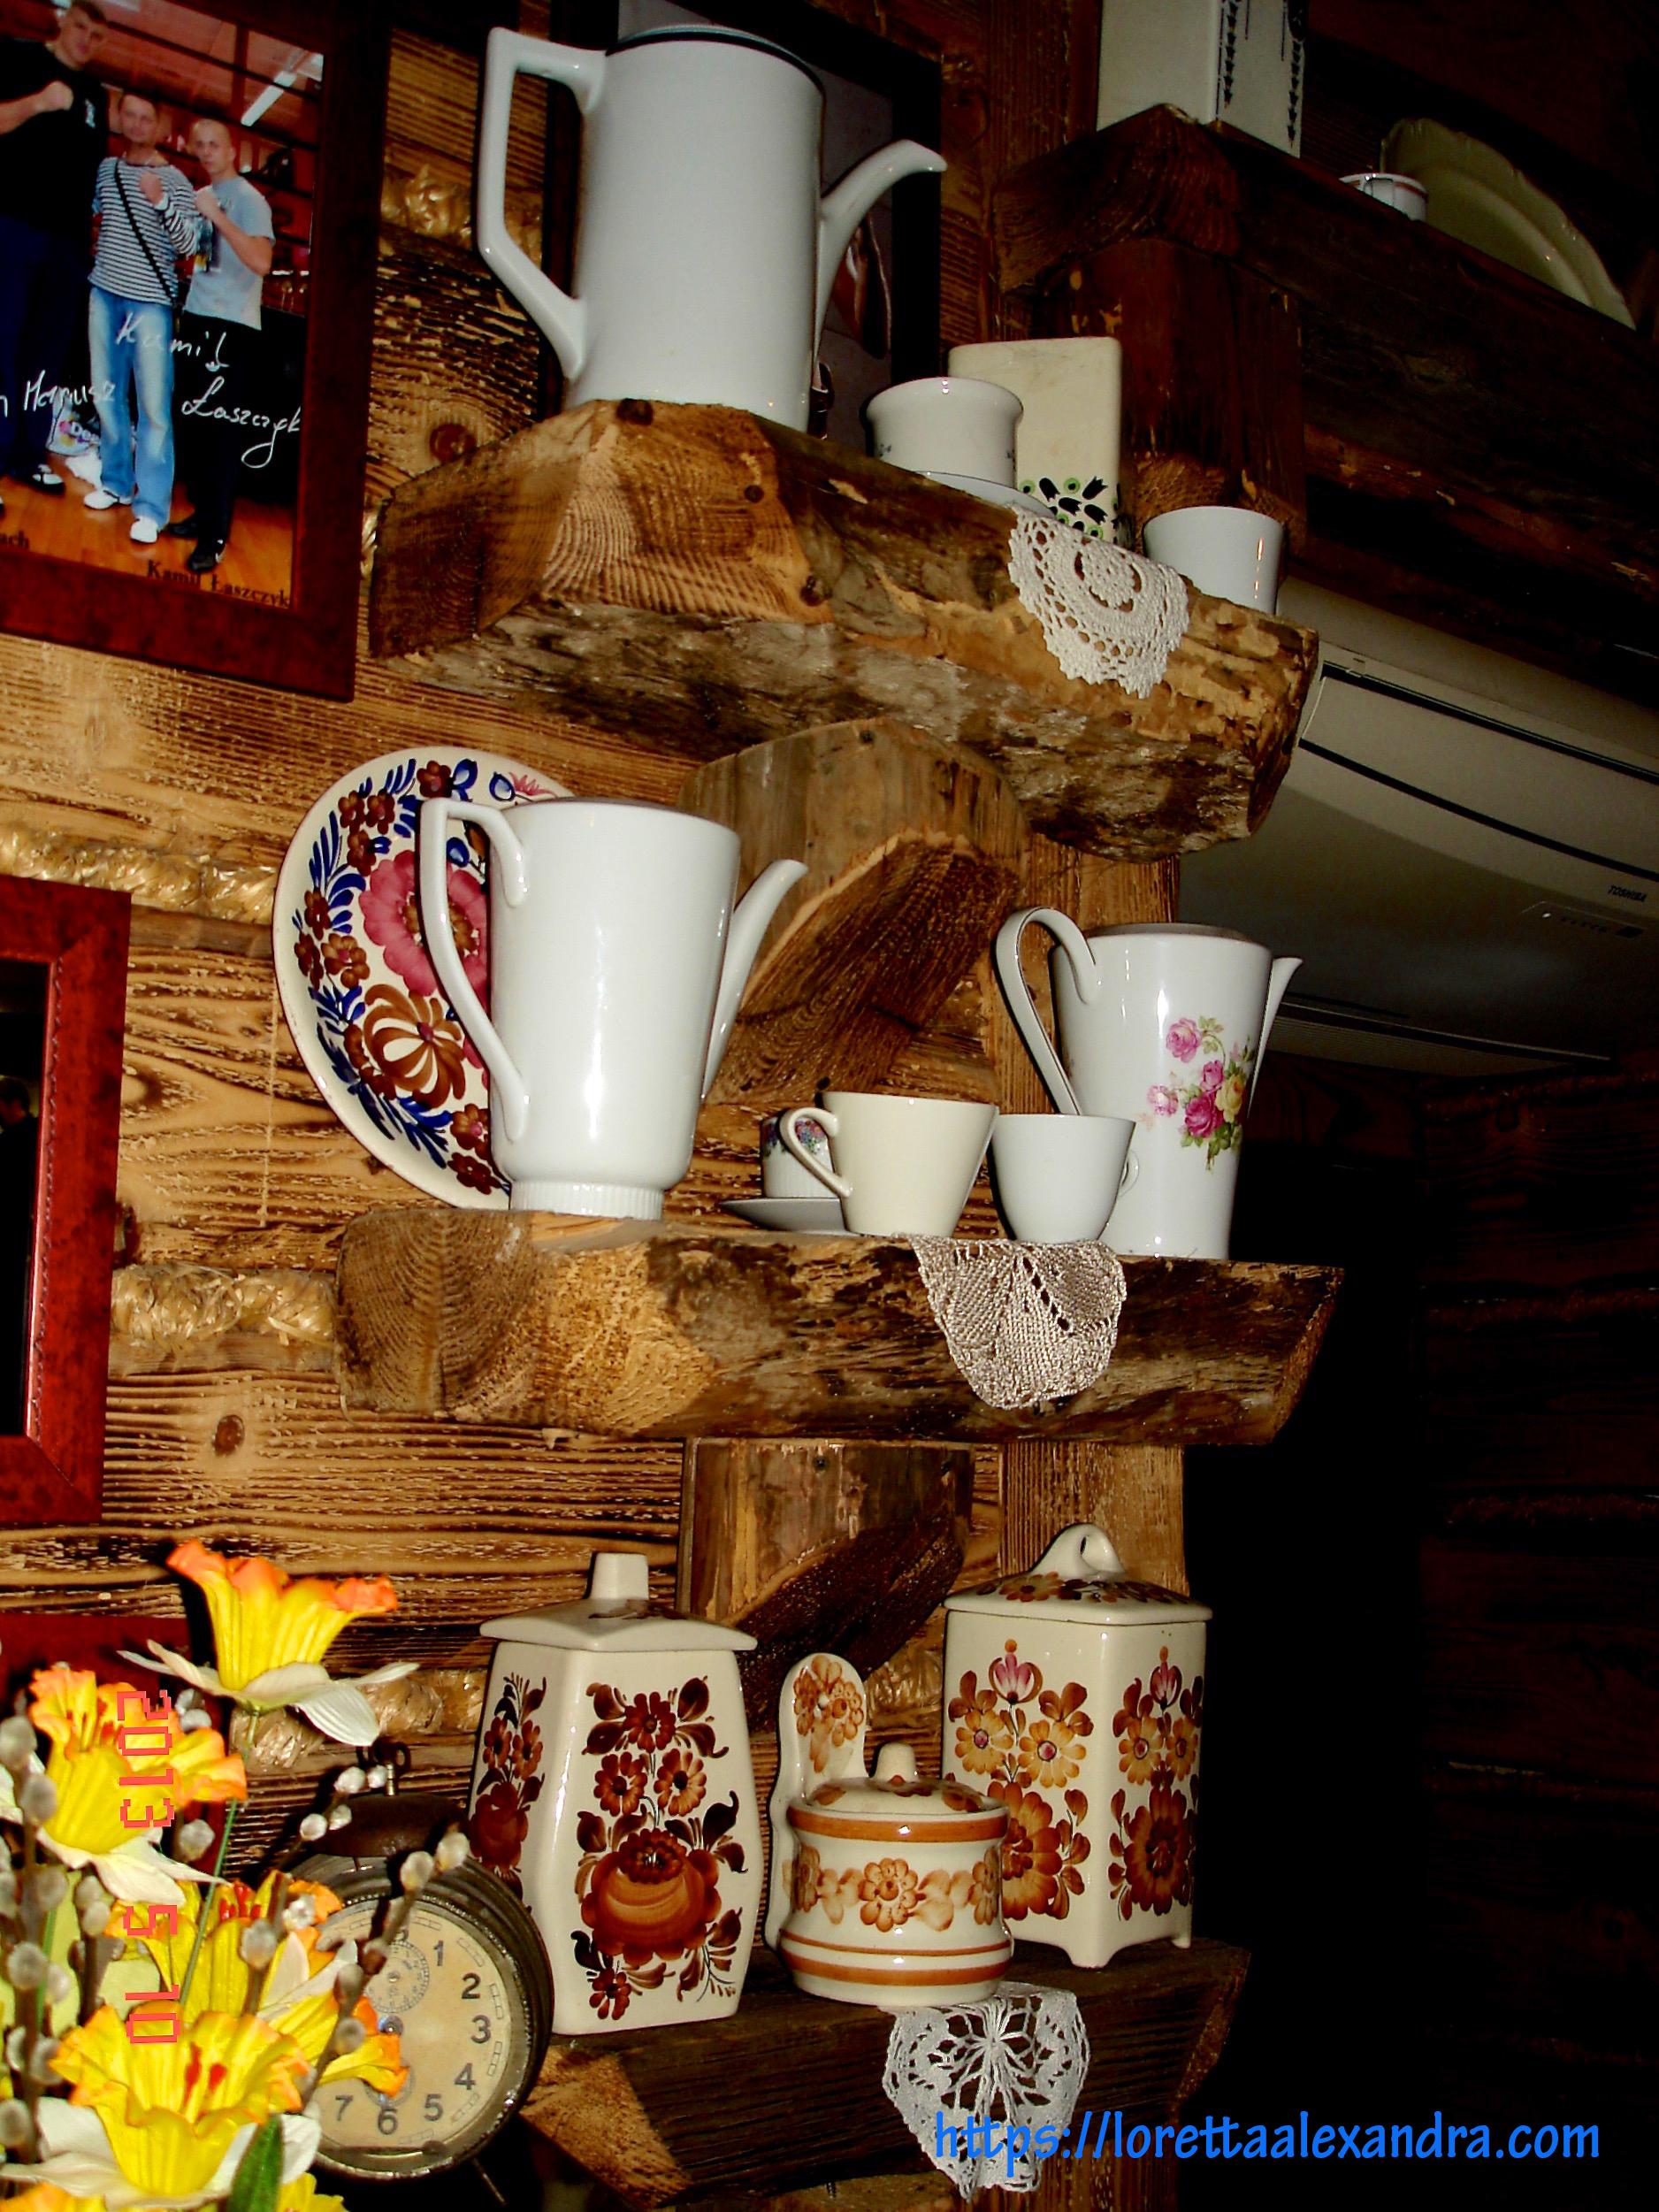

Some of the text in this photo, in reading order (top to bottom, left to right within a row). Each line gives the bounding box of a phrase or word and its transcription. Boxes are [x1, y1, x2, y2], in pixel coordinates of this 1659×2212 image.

[1607, 884, 1648, 903] TOSHIBA
[432, 1940, 445, 1966] 1
[461, 1971, 481, 2000] 2
[470, 2014, 492, 2044] 3
[454, 2062, 476, 2091] 4
[334, 2094, 354, 2122] 7
[378, 2108, 398, 2135] 6
[423, 2093, 443, 2122] 5
